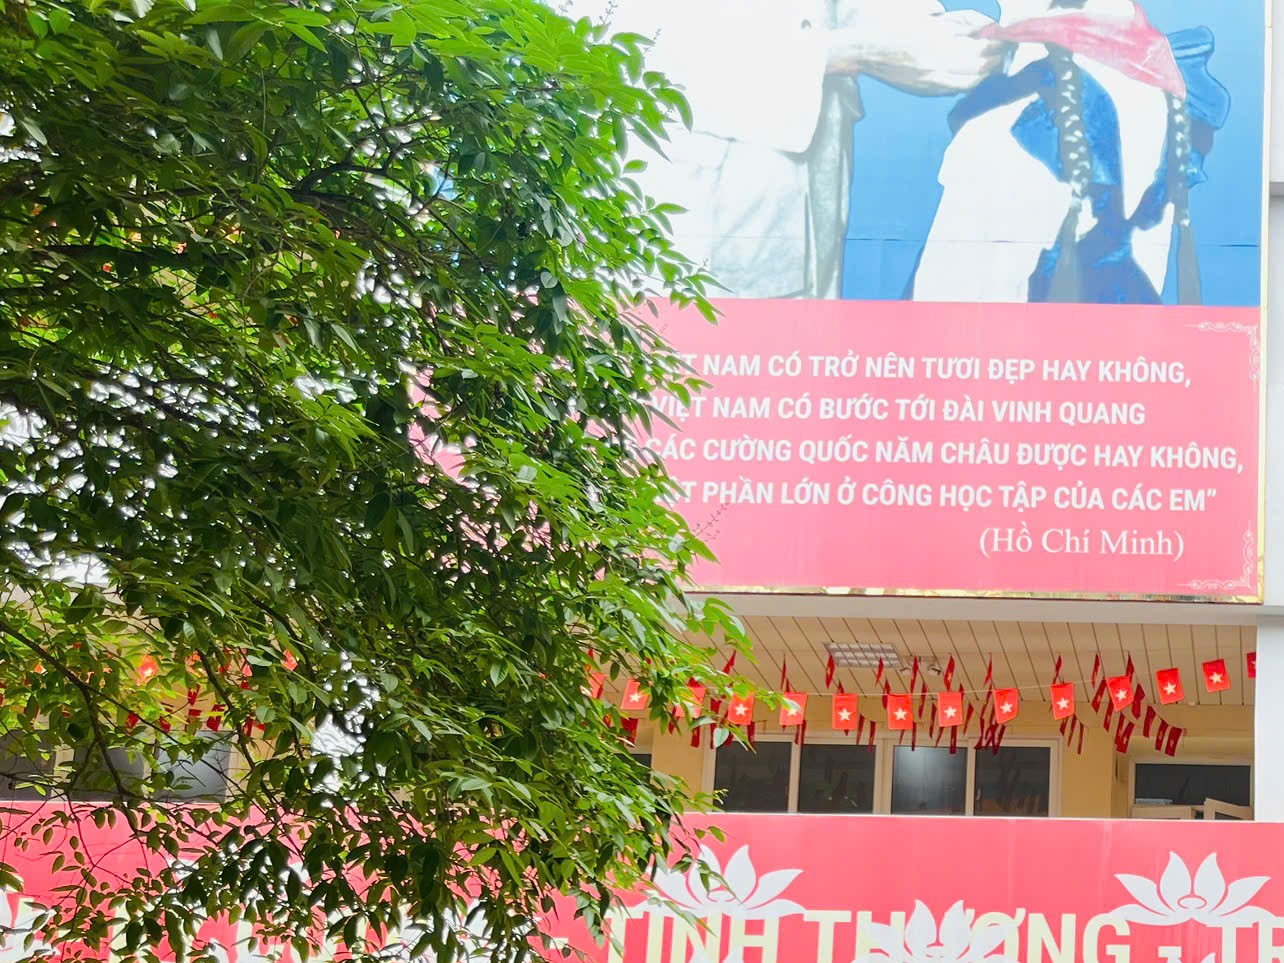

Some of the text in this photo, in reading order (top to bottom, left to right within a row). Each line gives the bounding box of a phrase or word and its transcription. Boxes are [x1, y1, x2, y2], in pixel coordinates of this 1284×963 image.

[703, 355, 760, 377] NAM
[768, 349, 801, 377] CÓ
[808, 350, 859, 378] TRỞ
[865, 352, 915, 378] NÊN
[922, 356, 980, 379] TƯƠI
[988, 358, 1035, 384] ĐẸP
[1043, 360, 1091, 381] HAY
[1099, 356, 1191, 388] KHÔNG,
[713, 397, 770, 419] NAM
[778, 392, 812, 419] CÓ
[820, 393, 888, 421] BƯỚC
[896, 394, 935, 421] TỚI
[943, 394, 984, 422] ĐÀI
[992, 401, 1051, 423] VINH
[1059, 402, 1145, 426] QUANG
[704, 437, 791, 462] CƯỜNG
[800, 434, 868, 464] QUỐC
[876, 436, 933, 463] NĂM
[940, 437, 1009, 464] CHÂU
[1017, 443, 1087, 471] ĐƯỢC
[1094, 446, 1143, 467] HAY
[1151, 441, 1244, 474] KHÔNG,
[703, 475, 774, 504] PHẦN
[781, 477, 829, 504] LỚN
[838, 476, 856, 505] Ở
[862, 478, 932, 506] CÔNG
[940, 485, 992, 512] HỌC
[999, 481, 1046, 512] TẬP
[1054, 480, 1105, 510] CỦA
[1112, 483, 1162, 510] CÁC
[980, 521, 1185, 561] (Hồ Chí Minh)
